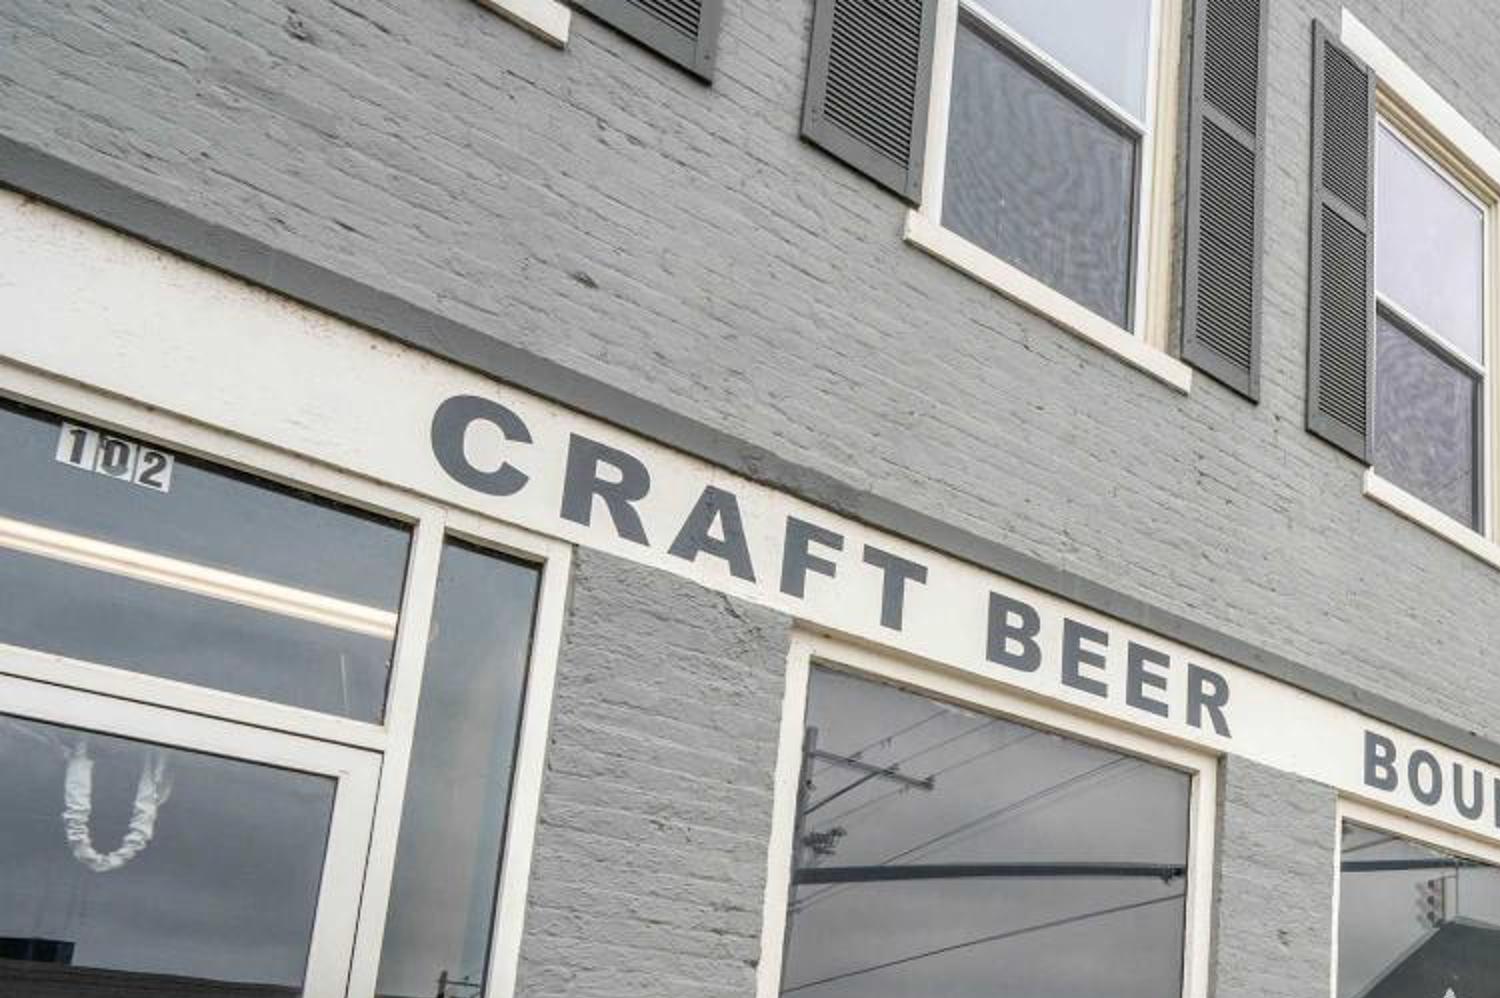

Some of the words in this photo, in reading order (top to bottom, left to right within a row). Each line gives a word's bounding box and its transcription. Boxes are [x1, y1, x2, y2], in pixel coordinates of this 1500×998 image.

[68, 429, 168, 489] 102
[431, 394, 928, 632] CRAFT
[986, 591, 1232, 738] BEER
